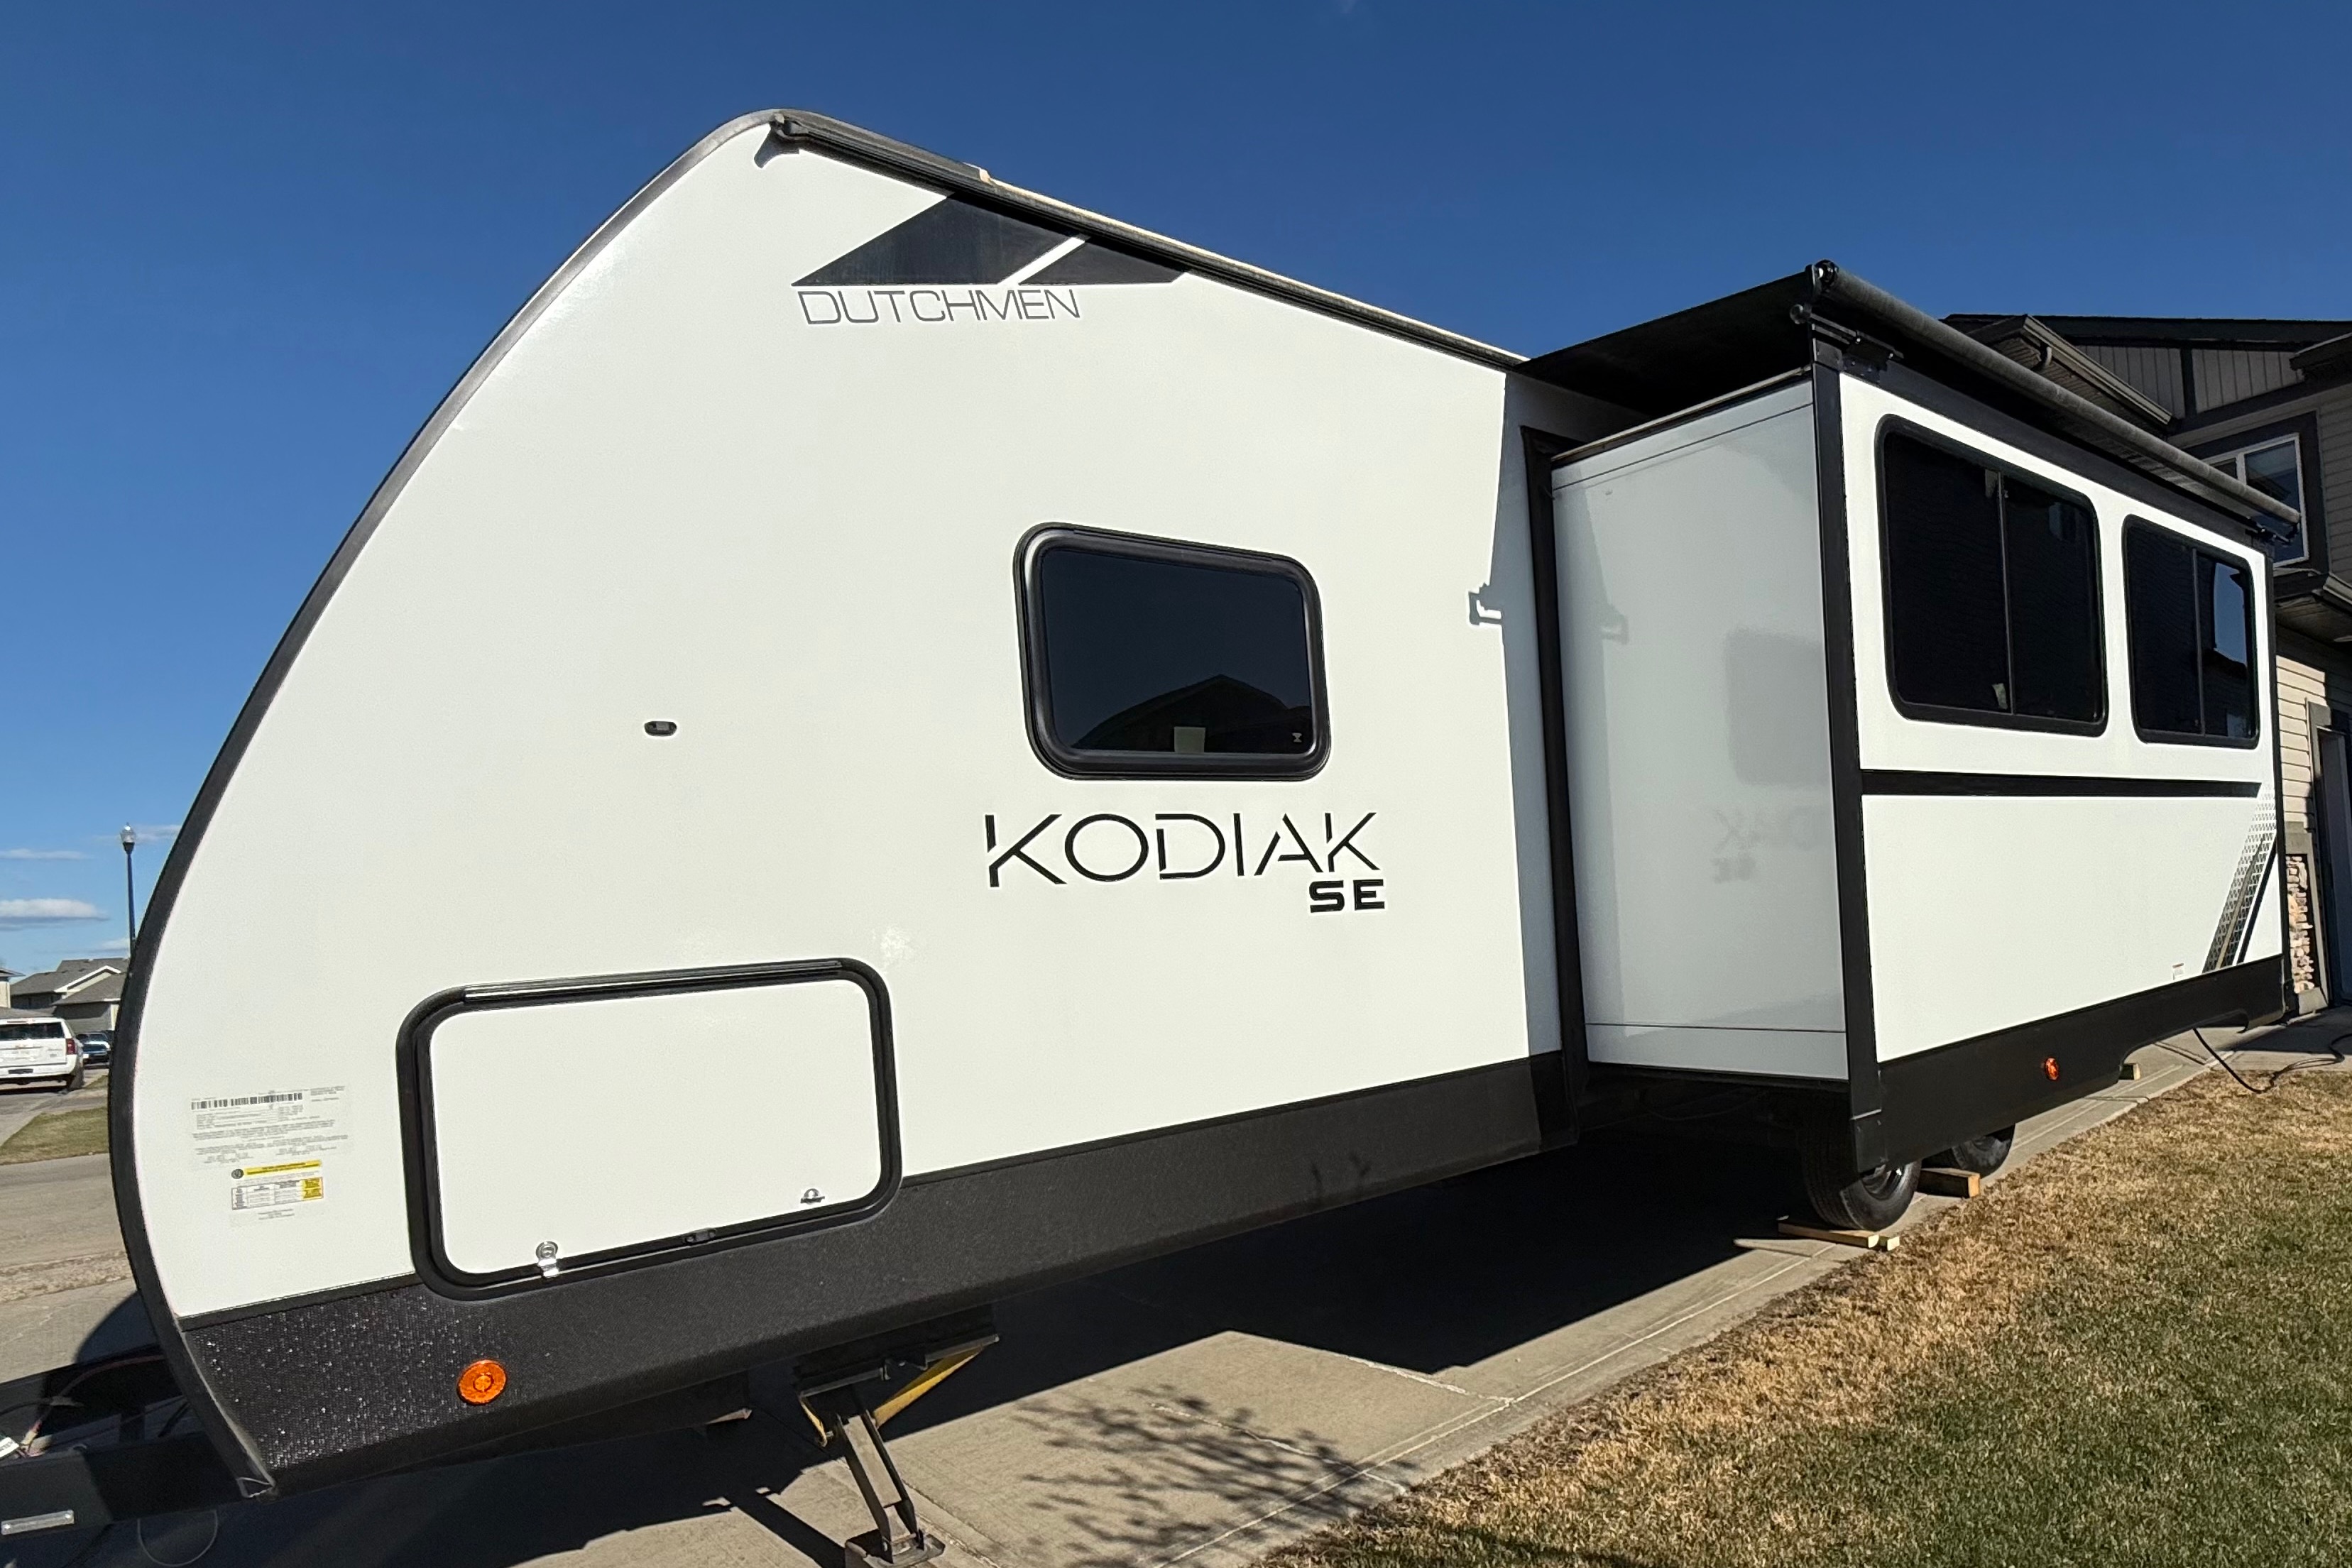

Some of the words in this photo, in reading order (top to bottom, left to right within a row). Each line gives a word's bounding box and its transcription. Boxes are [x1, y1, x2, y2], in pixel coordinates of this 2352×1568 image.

[797, 288, 1081, 324] DUTCHMEN
[985, 811, 1381, 887] KODIAK
[1310, 878, 1386, 913] SE
